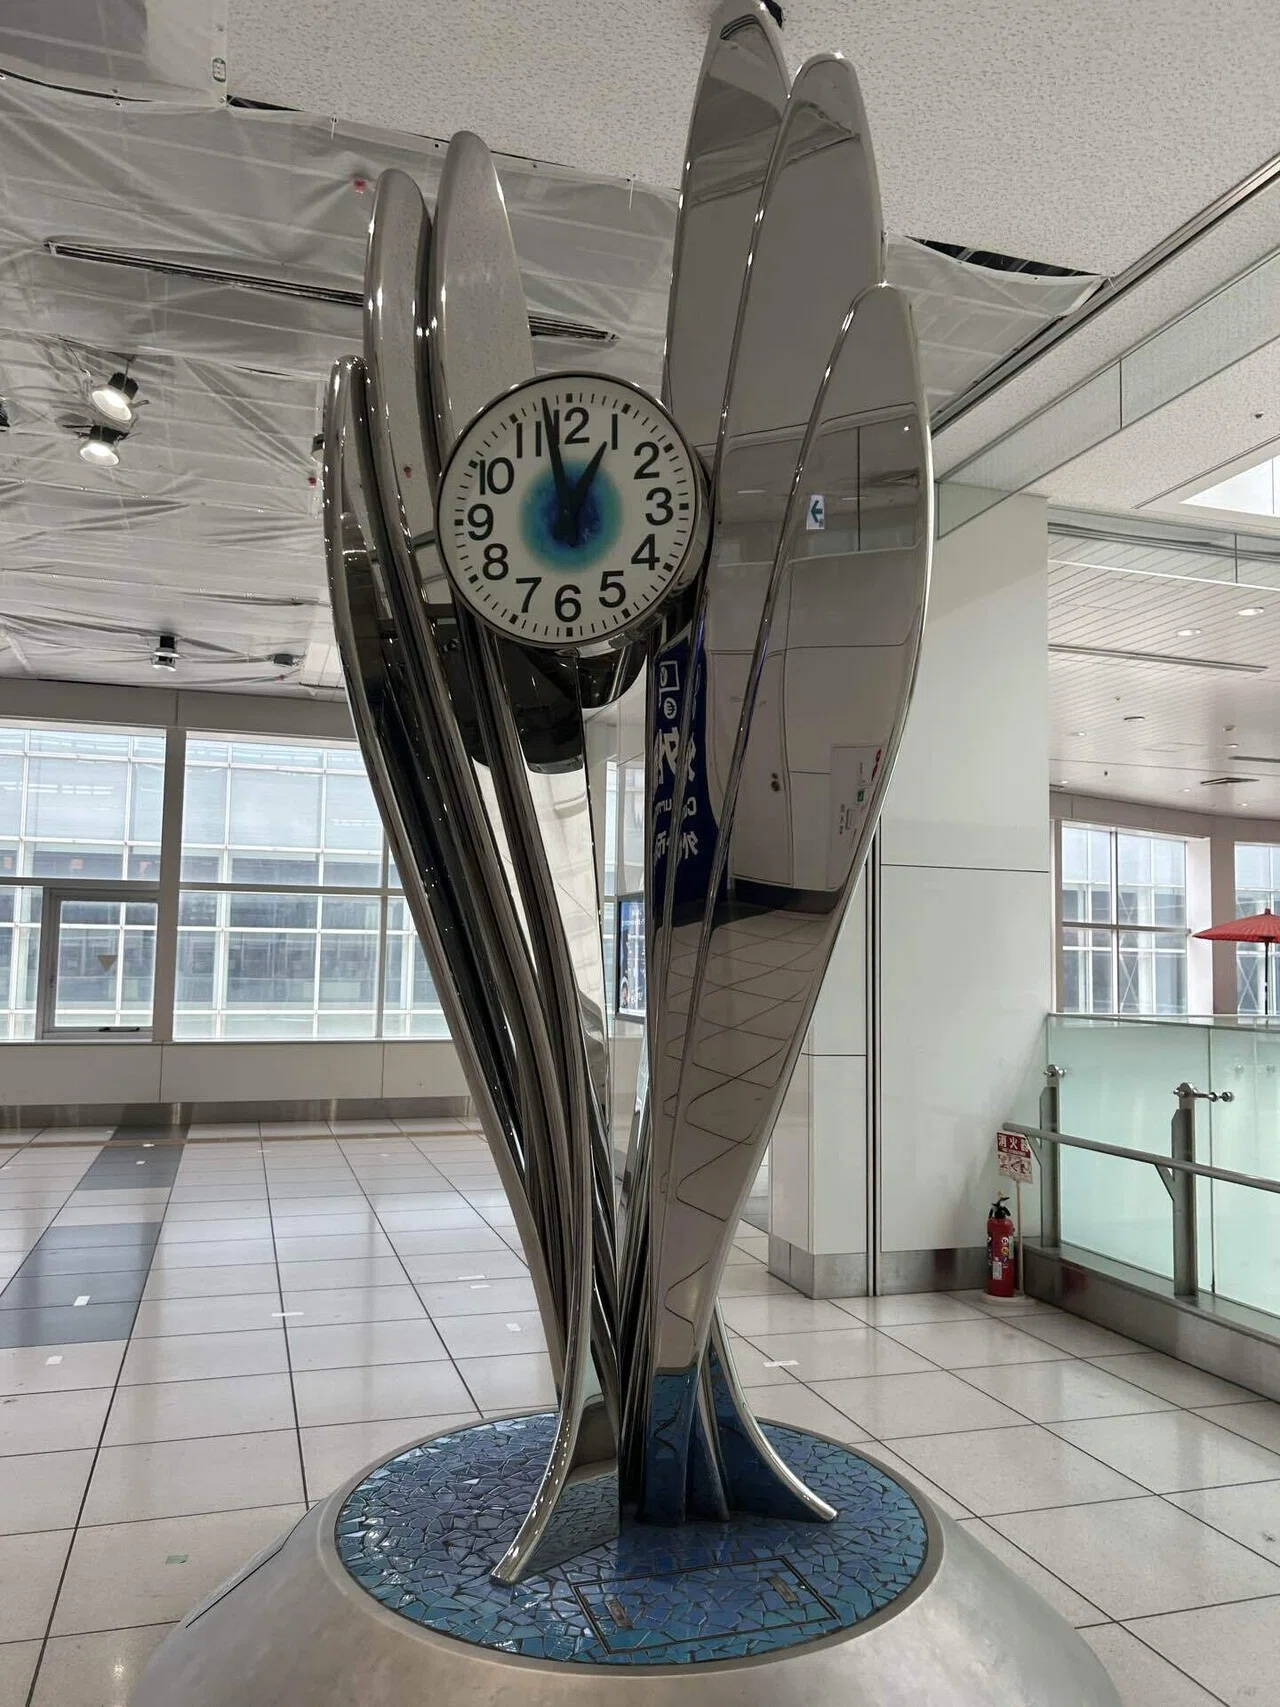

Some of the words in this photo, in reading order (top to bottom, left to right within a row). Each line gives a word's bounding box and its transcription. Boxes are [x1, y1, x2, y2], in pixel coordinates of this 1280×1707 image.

[516, 421, 542, 459] 11
[553, 406, 591, 445] 12
[479, 456, 515, 496] 10
[633, 442, 660, 479] 2
[467, 503, 494, 541] 9
[645, 487, 674, 526] 3
[482, 543, 509, 581] 8
[631, 533, 660, 571] 4
[516, 576, 542, 613] 7
[554, 584, 582, 623] 6
[598, 570, 626, 608] 5
